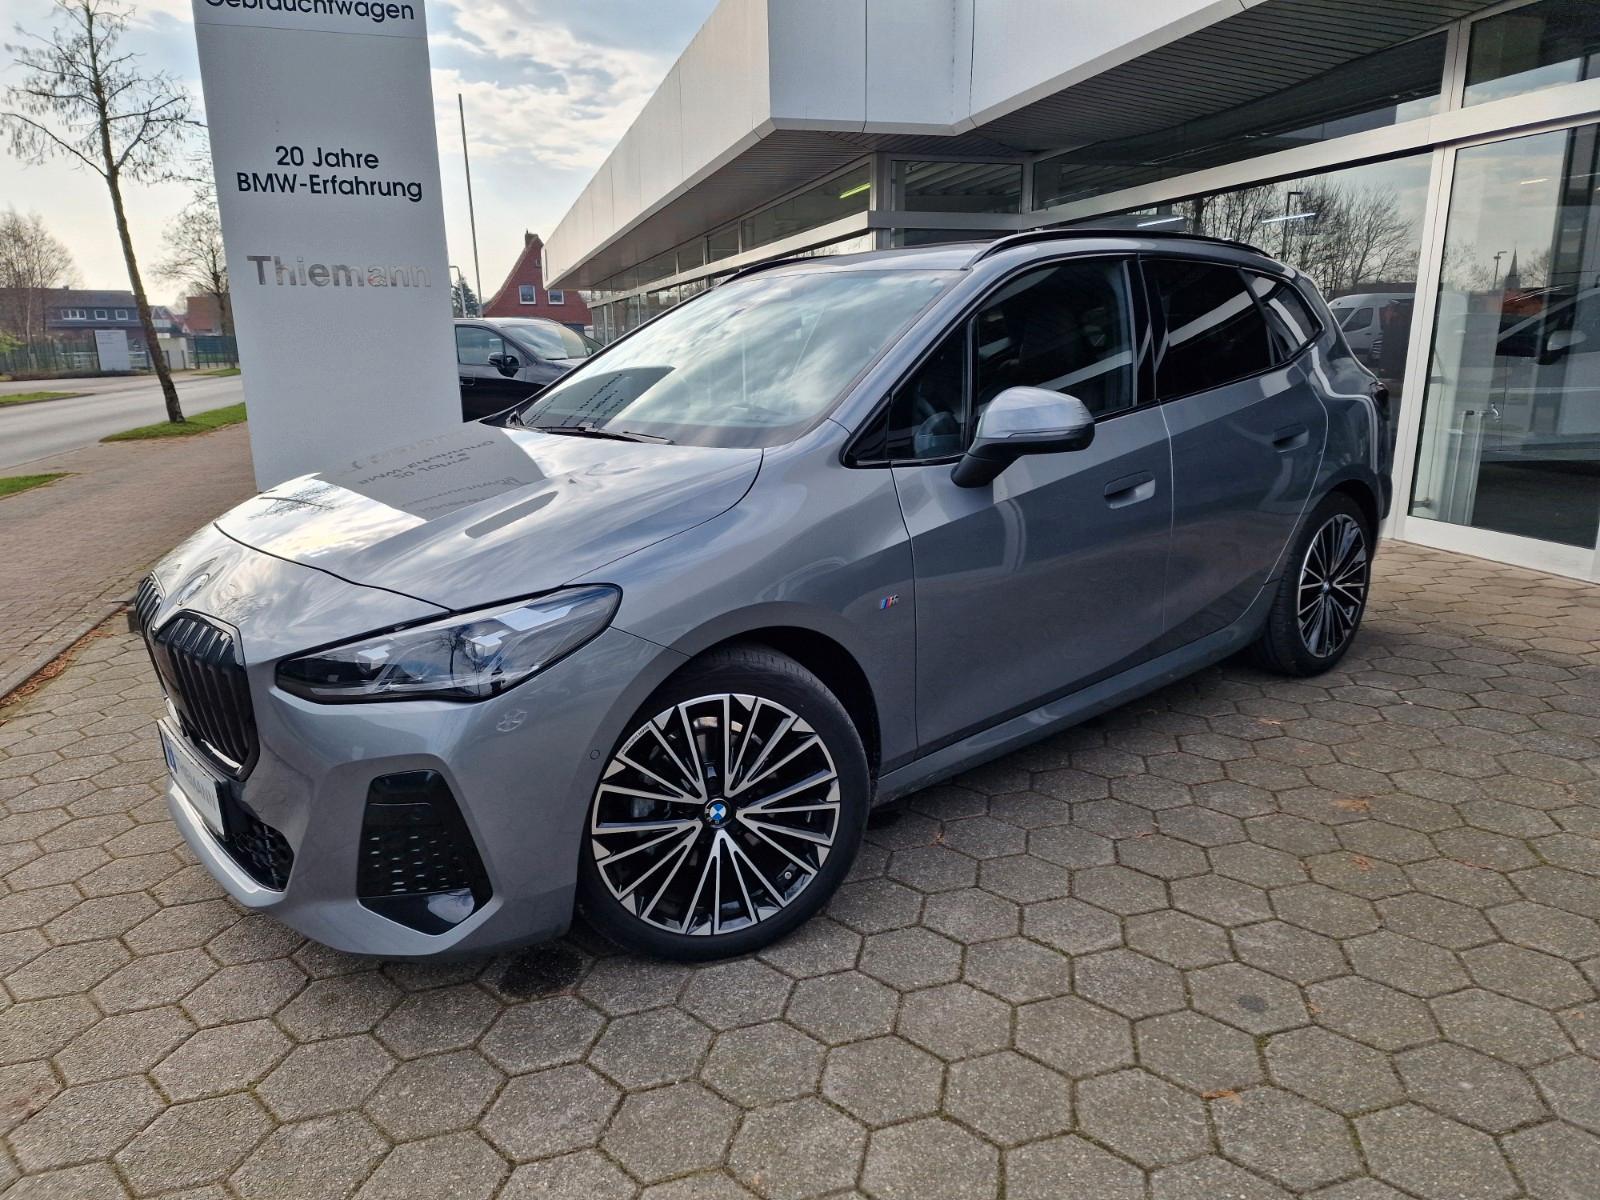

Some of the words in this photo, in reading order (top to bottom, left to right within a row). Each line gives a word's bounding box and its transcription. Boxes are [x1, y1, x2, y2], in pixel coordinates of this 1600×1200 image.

[275, 145, 304, 167] 20
[312, 147, 379, 170] Jahre
[236, 172, 423, 203] BMW-Erfahrung
[246, 255, 432, 288] Thiemann
